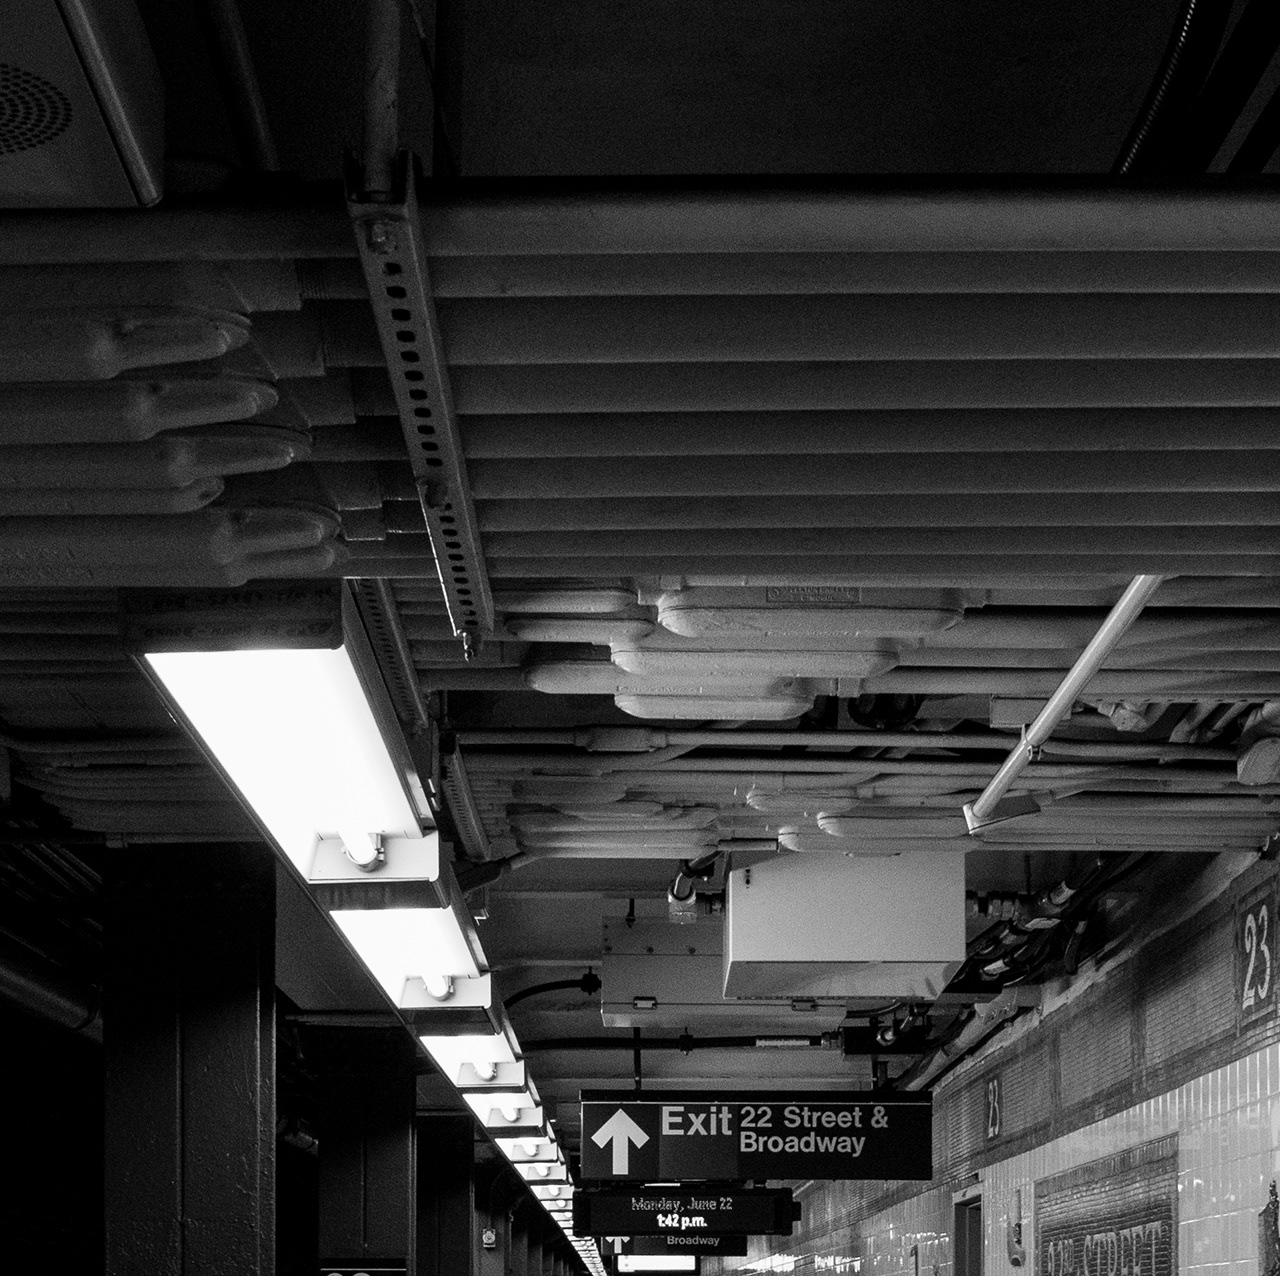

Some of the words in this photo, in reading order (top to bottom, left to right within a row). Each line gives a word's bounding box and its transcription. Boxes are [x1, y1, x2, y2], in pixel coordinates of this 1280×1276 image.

[1241, 904, 1271, 1011] 23
[661, 1105, 733, 1137] Exit
[739, 1105, 774, 1129] 22
[783, 1105, 863, 1129] Street
[870, 1105, 889, 1130] &
[739, 1130, 867, 1158] Broadway
[631, 1196, 685, 1214] Monday,
[687, 1196, 717, 1212] June
[719, 1196, 734, 1211] 22
[681, 1215, 709, 1231] p.m.
[666, 1235, 721, 1248] Broadway
